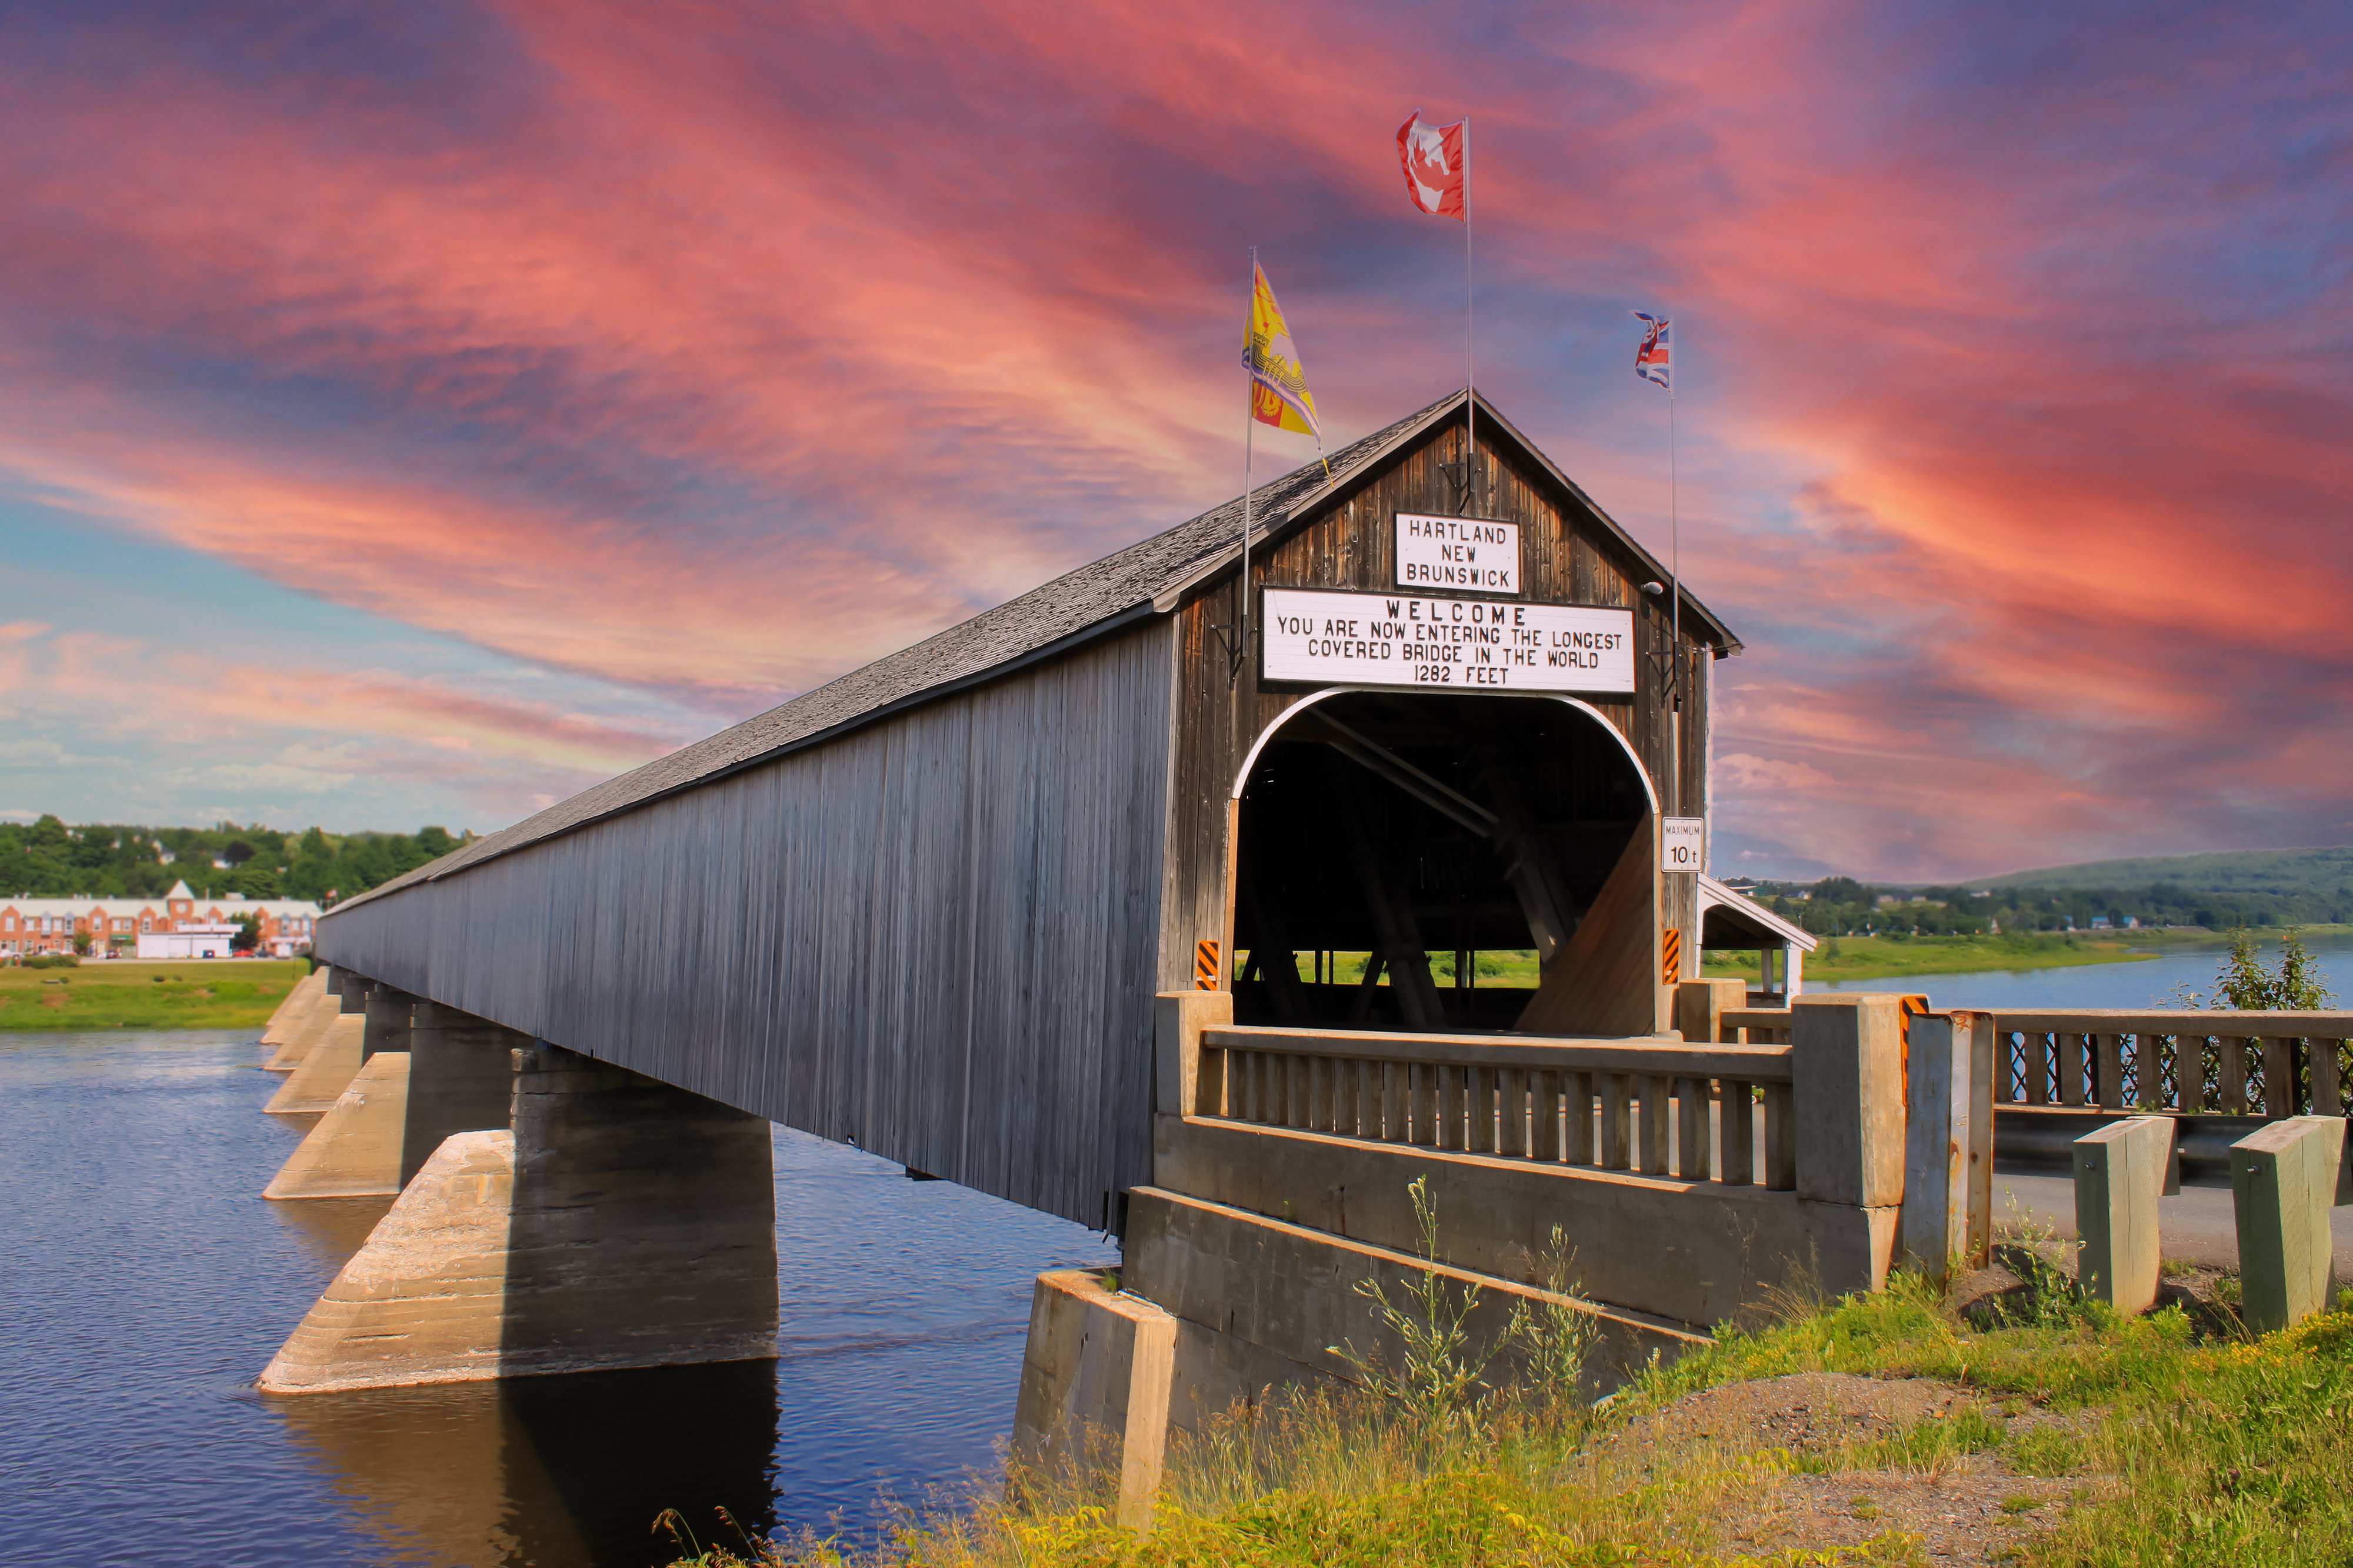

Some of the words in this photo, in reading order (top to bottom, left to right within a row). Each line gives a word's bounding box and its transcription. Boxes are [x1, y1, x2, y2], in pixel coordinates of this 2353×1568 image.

[1410, 519, 1506, 545] HARTLAND
[1442, 544, 1476, 563] NEW
[1407, 563, 1509, 587] BRUNSWICK
[1386, 599, 1525, 626] WELCOME
[1277, 616, 1313, 636] YOU
[1325, 619, 1358, 638] ARE
[1371, 621, 1406, 640] NOW
[1416, 623, 1500, 645] ENTERING
[1511, 628, 1542, 647] THE
[1552, 630, 1622, 650] LONGEST
[1308, 639, 1391, 660] COVERED
[1402, 643, 1462, 663] BRIDGE
[1475, 647, 1491, 664] IN
[1502, 648, 1537, 666] THE
[1548, 650, 1598, 669] WORLD
[1414, 665, 1451, 683] 1282
[1466, 666, 1509, 685] FEET
[1665, 825, 1699, 836] MAXIMUM
[1671, 846, 1688, 863] 10
[1692, 850, 1697, 863] t
